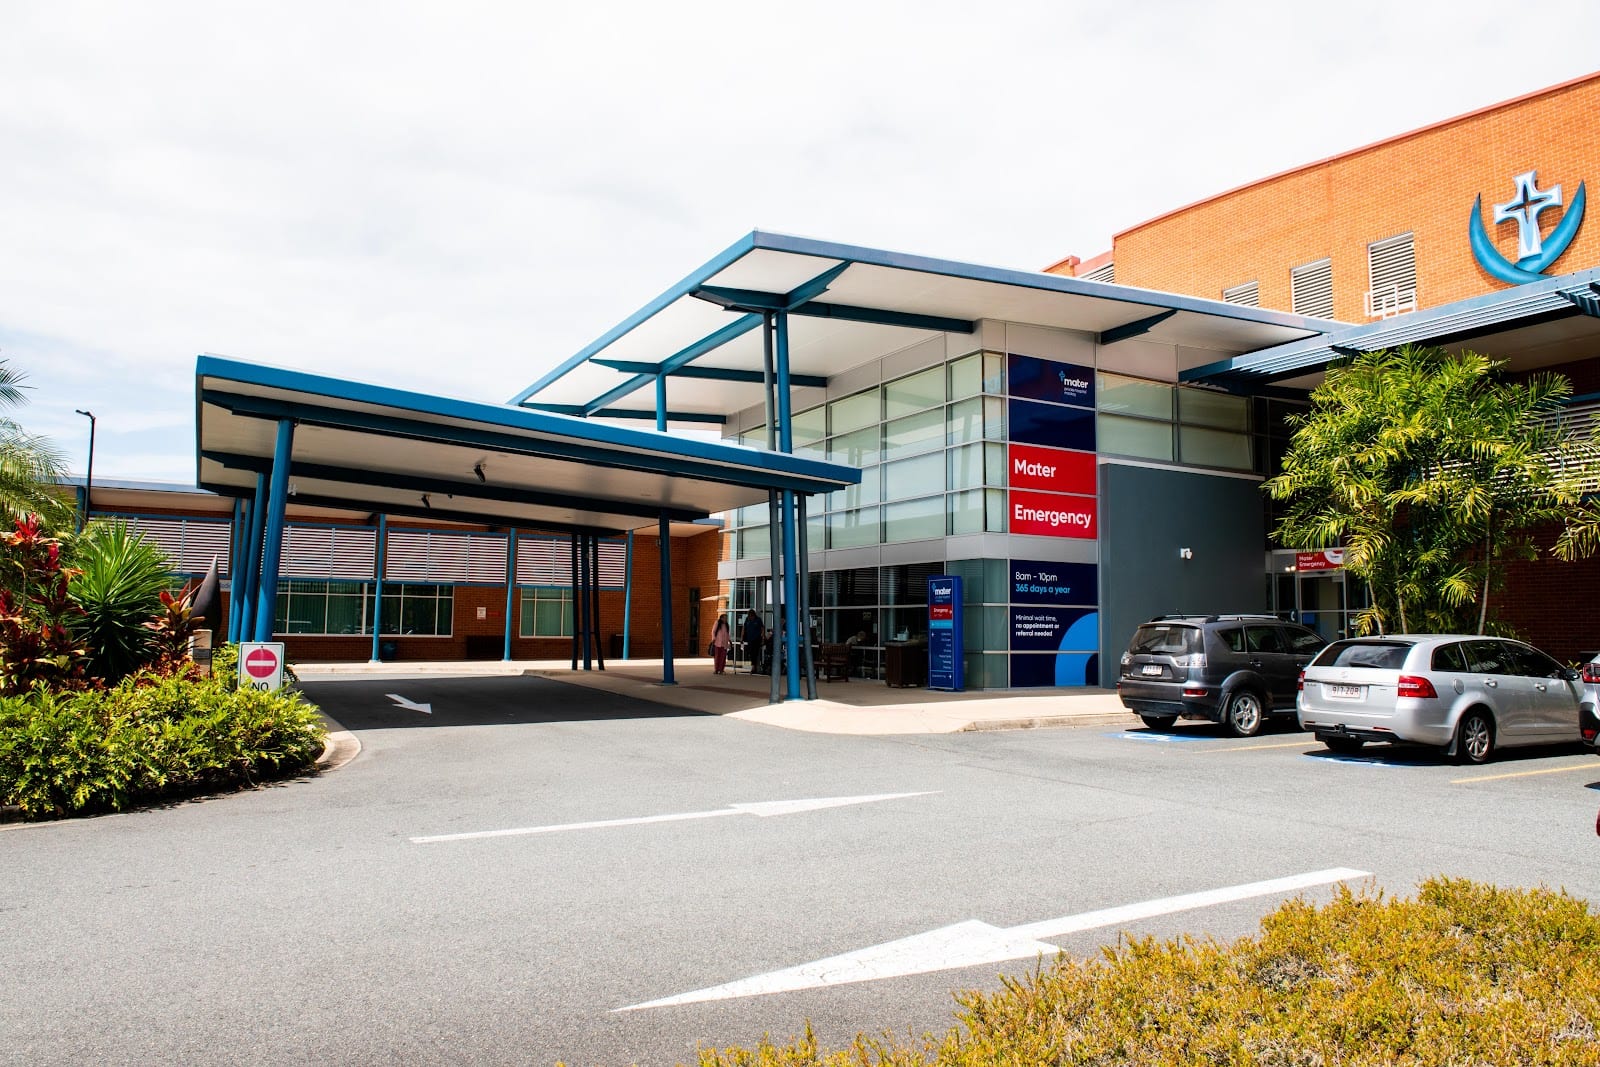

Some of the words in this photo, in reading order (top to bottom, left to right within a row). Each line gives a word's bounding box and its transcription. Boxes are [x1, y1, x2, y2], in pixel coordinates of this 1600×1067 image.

[1064, 378, 1089, 389] mater
[1014, 458, 1057, 478] Mater
[1014, 503, 1092, 529] Emergency
[1015, 571, 1032, 581] 8am
[1038, 572, 1058, 583] 10pm
[935, 587, 951, 595] mater
[1015, 583, 1029, 592] 365
[1030, 584, 1047, 594] days
[1054, 586, 1071, 595] year
[251, 682, 269, 692] NO
